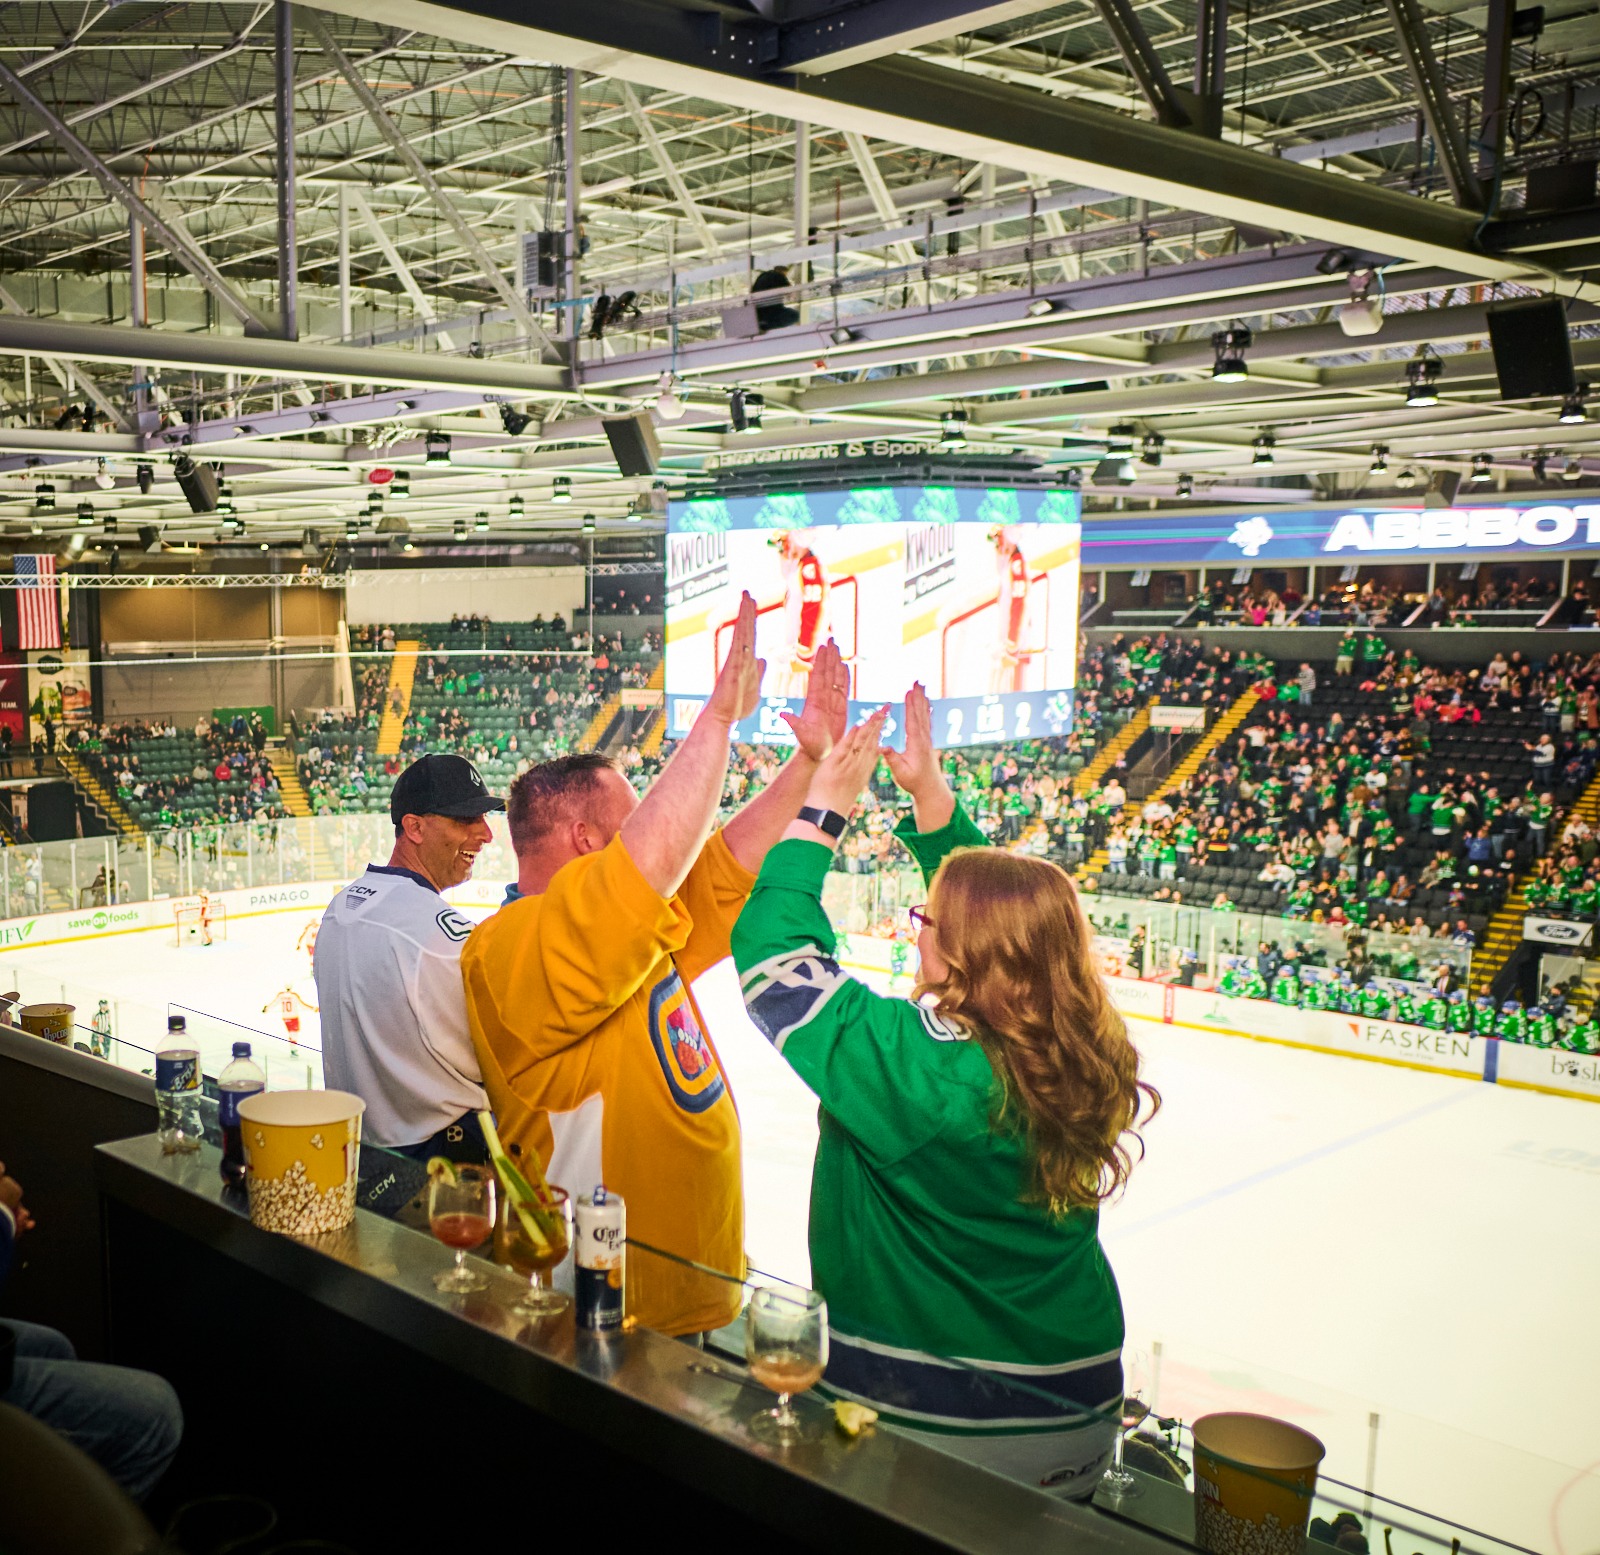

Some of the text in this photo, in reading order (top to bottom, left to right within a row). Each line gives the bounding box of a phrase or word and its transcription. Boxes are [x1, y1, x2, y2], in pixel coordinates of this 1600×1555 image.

[846, 442, 867, 457] &
[946, 708, 963, 744] 2
[1014, 702, 1031, 737] 2
[250, 890, 309, 906] PANAGO
[349, 885, 377, 896] CCM
[282, 1001, 292, 1012] 10
[1366, 1026, 1470, 1058] FASKEN
[368, 1173, 396, 1201] CCM
